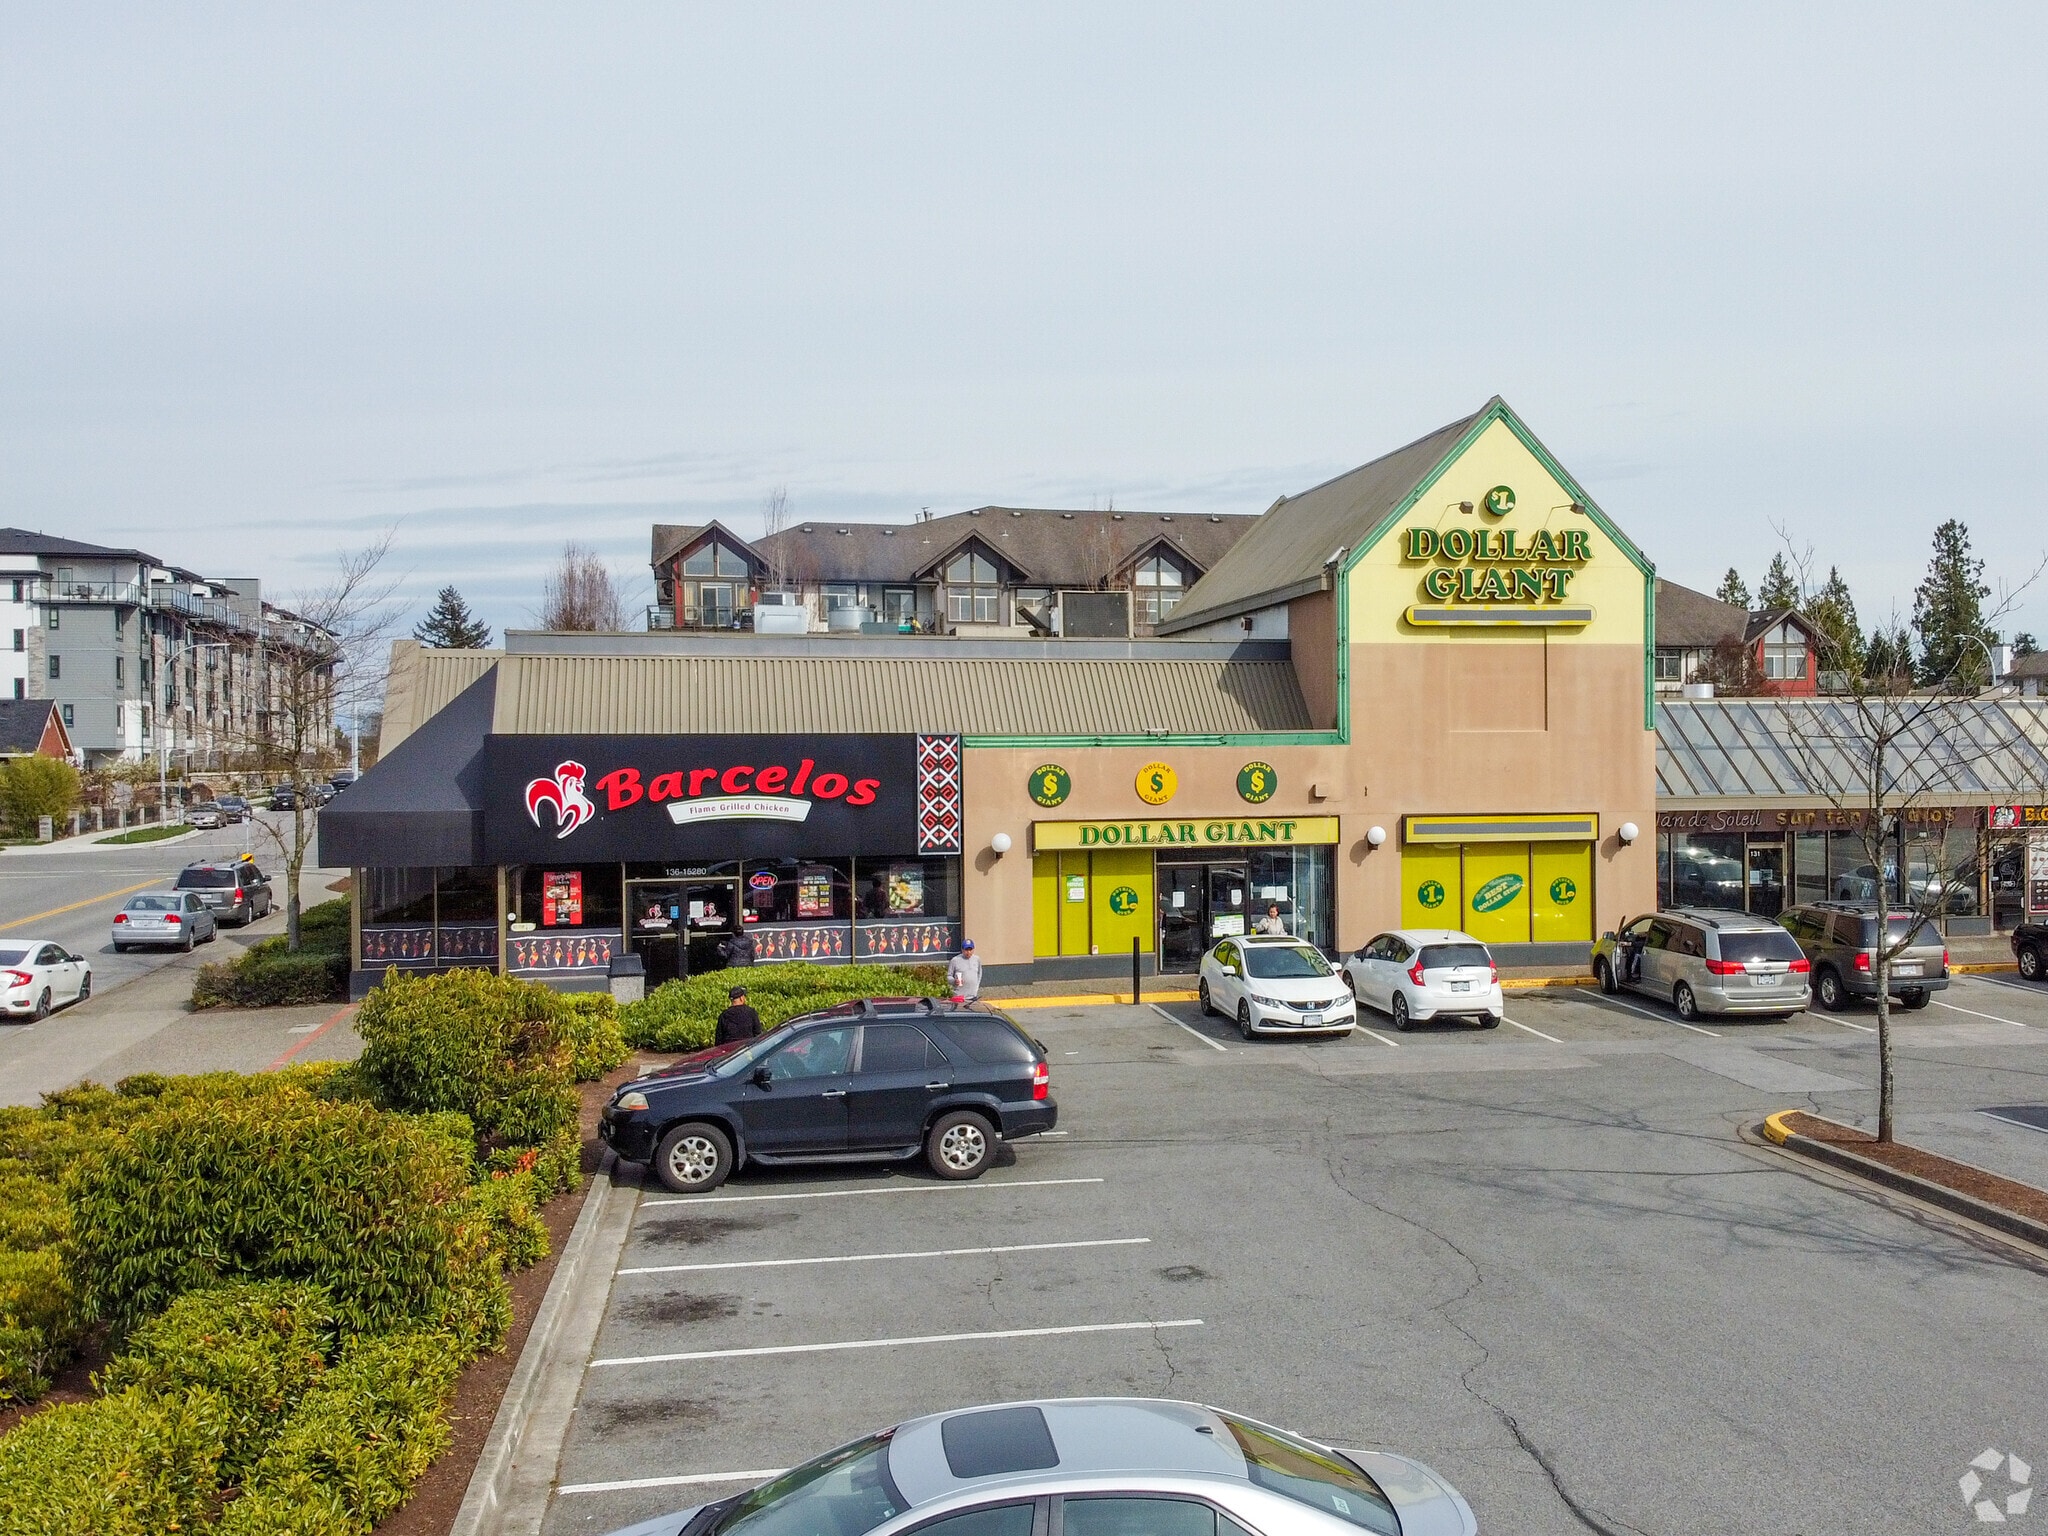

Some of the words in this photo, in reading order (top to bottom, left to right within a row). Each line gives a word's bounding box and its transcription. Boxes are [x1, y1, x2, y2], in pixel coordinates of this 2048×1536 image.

[1406, 527, 1594, 561] DOLLAR
[1425, 566, 1575, 600] GIANT
[1036, 765, 1066, 776] DOLLAR
[1143, 763, 1171, 774] DOLLAR
[1243, 762, 1271, 773] DOLLAR
[596, 759, 880, 811] Barcelos
[1037, 795, 1063, 806] GIANT
[1144, 794, 1168, 803] GIANT
[1245, 792, 1270, 802] GIANT
[689, 805, 717, 815] Flame
[719, 803, 751, 812] Grilled
[753, 803, 790, 813] Chicken
[1687, 810, 1708, 827] de
[1710, 810, 1762, 831] Soleil
[1079, 823, 1199, 846] DOLLAR
[1203, 820, 1298, 844] GIANT
[665, 867, 708, 876] 136-15280
[751, 876, 776, 886] OPEN
[1483, 881, 1509, 900] BEST
[1477, 893, 1504, 912] DOLLAR
